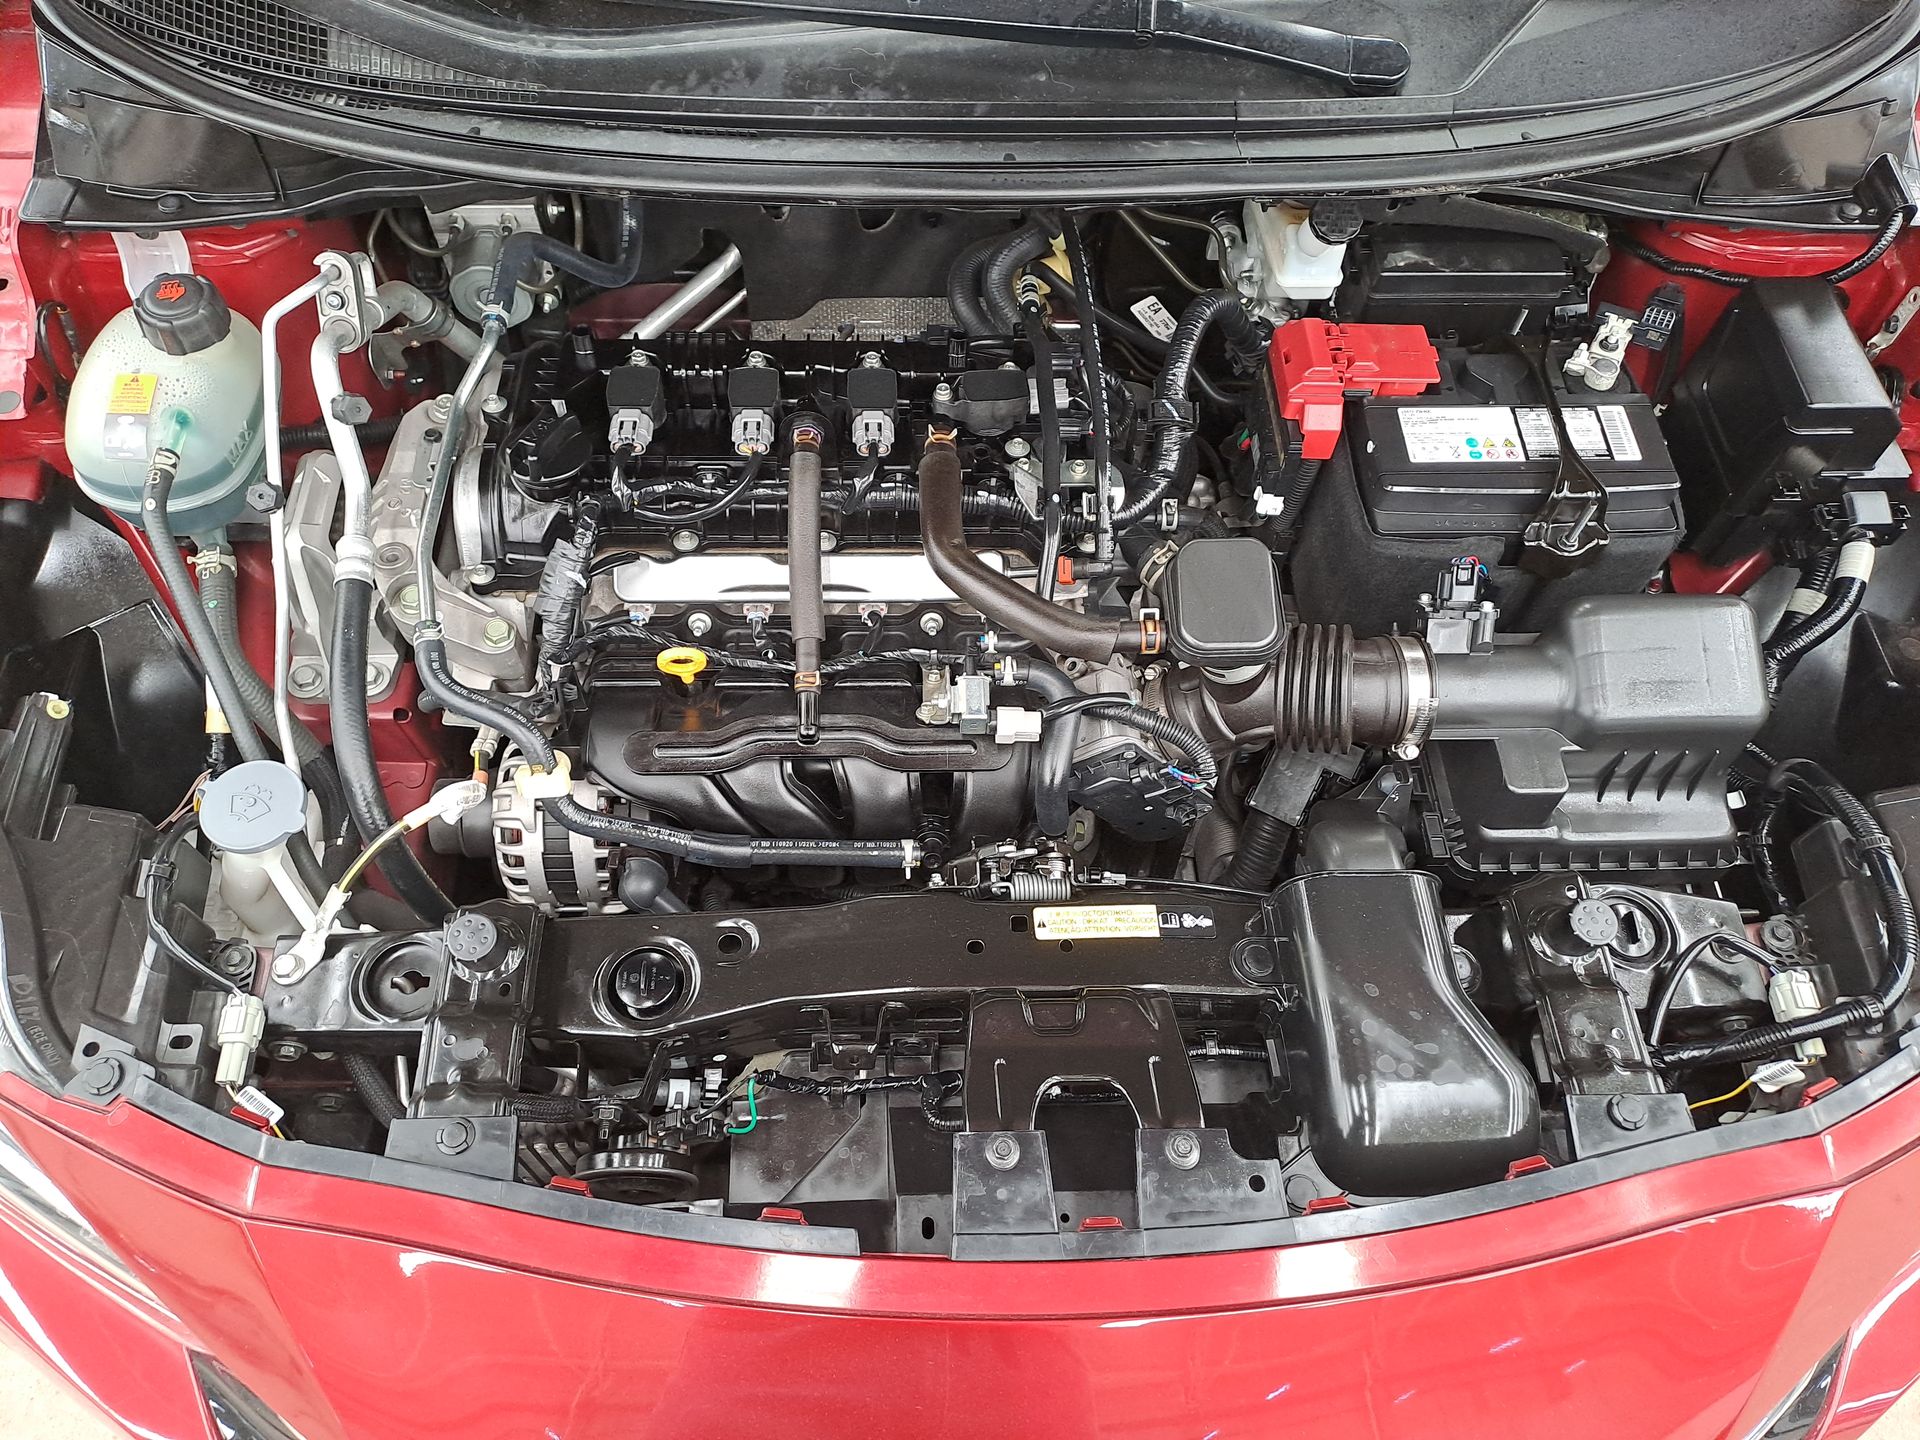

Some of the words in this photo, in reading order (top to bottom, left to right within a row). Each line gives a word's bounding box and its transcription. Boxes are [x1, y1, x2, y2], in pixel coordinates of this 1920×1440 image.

[1147, 302, 1163, 316] EA
[1083, 925, 1121, 933] ATTENTION
[26, 1024, 48, 1044] (ECE
